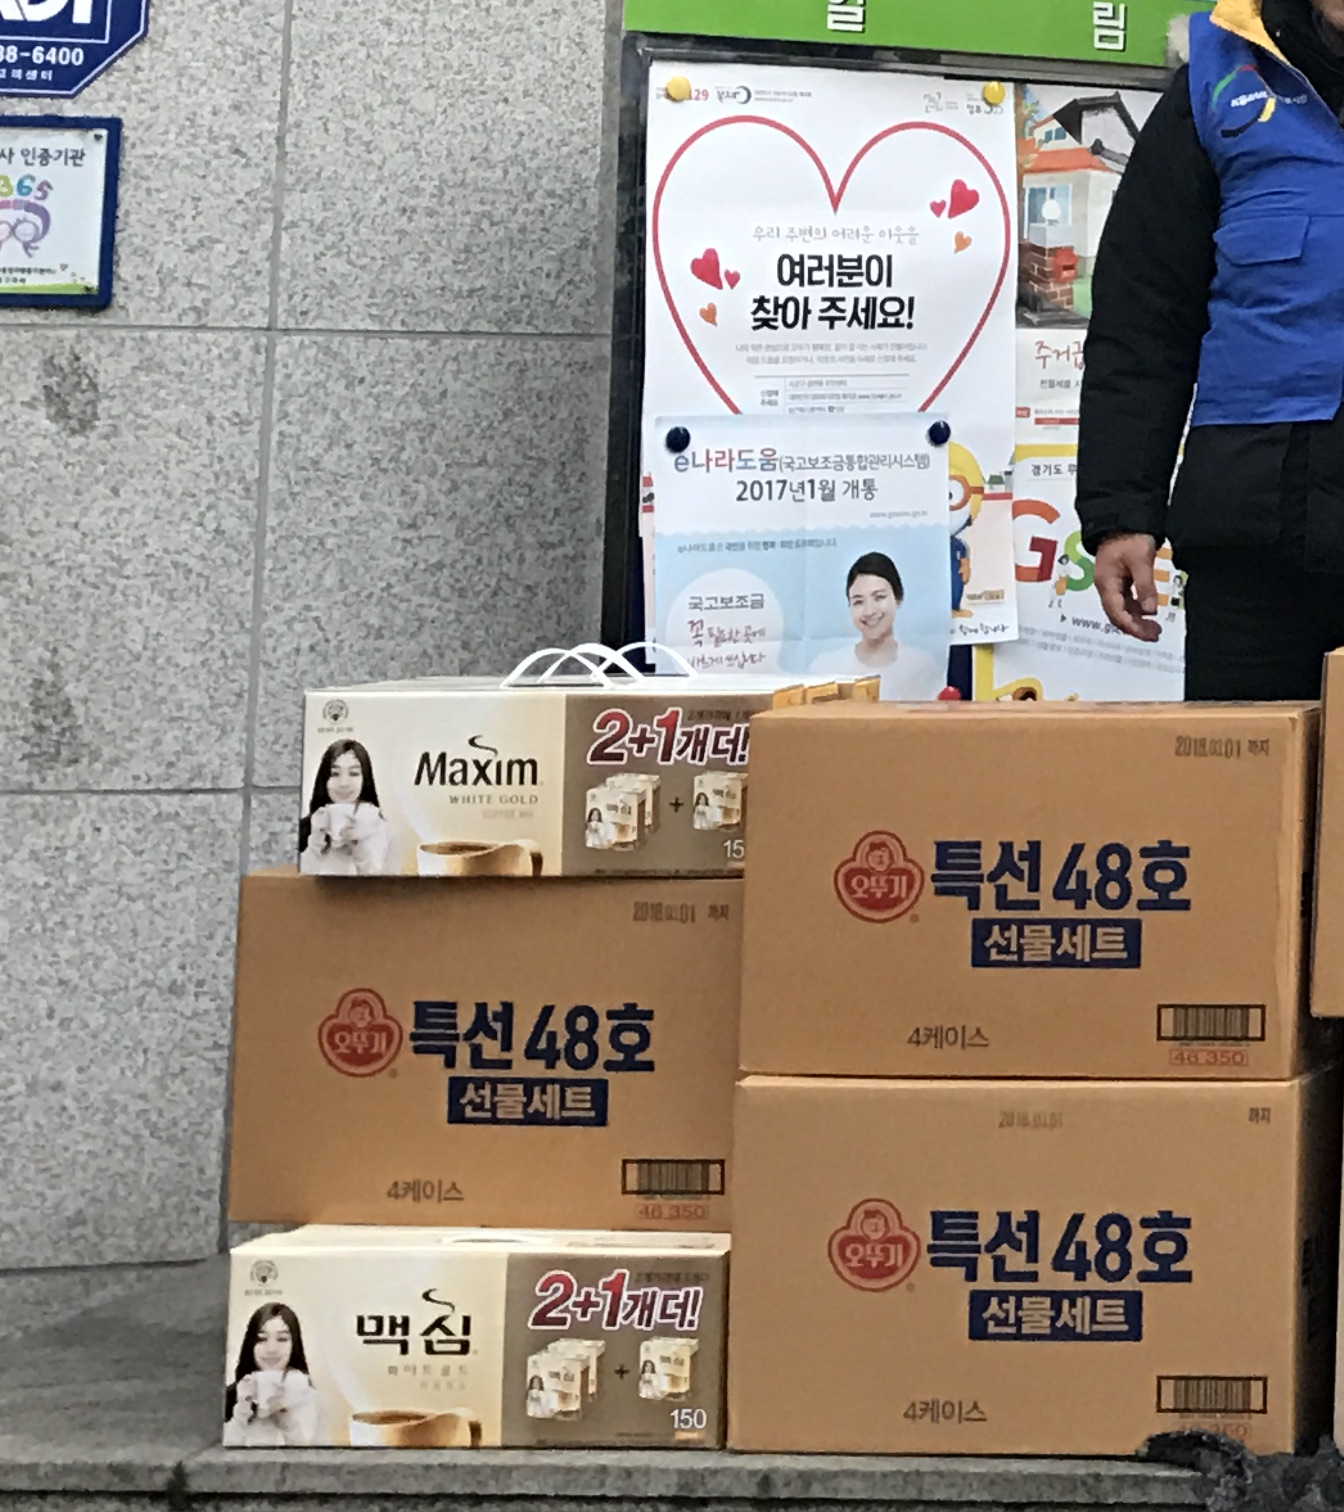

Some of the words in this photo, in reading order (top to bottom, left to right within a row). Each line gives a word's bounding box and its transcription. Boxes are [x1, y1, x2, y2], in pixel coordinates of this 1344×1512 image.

[0, 45, 84, 66] 8-6400
[20, 146, 86, 167] 인증기관
[753, 225, 780, 242] 우리
[832, 226, 873, 243] 어려운
[879, 225, 918, 245] 이웃을
[777, 254, 893, 288] 여러분이
[751, 295, 812, 331] 찾아
[818, 296, 915, 330] 주세요!
[1032, 464, 1063, 477] 경기도
[842, 479, 878, 501] 개통
[688, 593, 764, 611] 국고보조금
[415, 751, 539, 786] Maxim
[449, 794, 494, 805] WHITE
[499, 794, 539, 805] GOLD
[851, 874, 909, 899] 오뚜기
[984, 925, 1129, 962] 선물세트
[334, 1030, 387, 1055] 오뚜기
[907, 1025, 989, 1050] 4케이스
[459, 1083, 596, 1119] 선물세트
[387, 1179, 465, 1202] 4케이스
[844, 1244, 904, 1270] 오뚜기
[982, 1298, 1129, 1335] 선물세트
[355, 1311, 472, 1356] 맥심
[670, 1408, 708, 1429] 150
[904, 1400, 987, 1423] 4케이스
